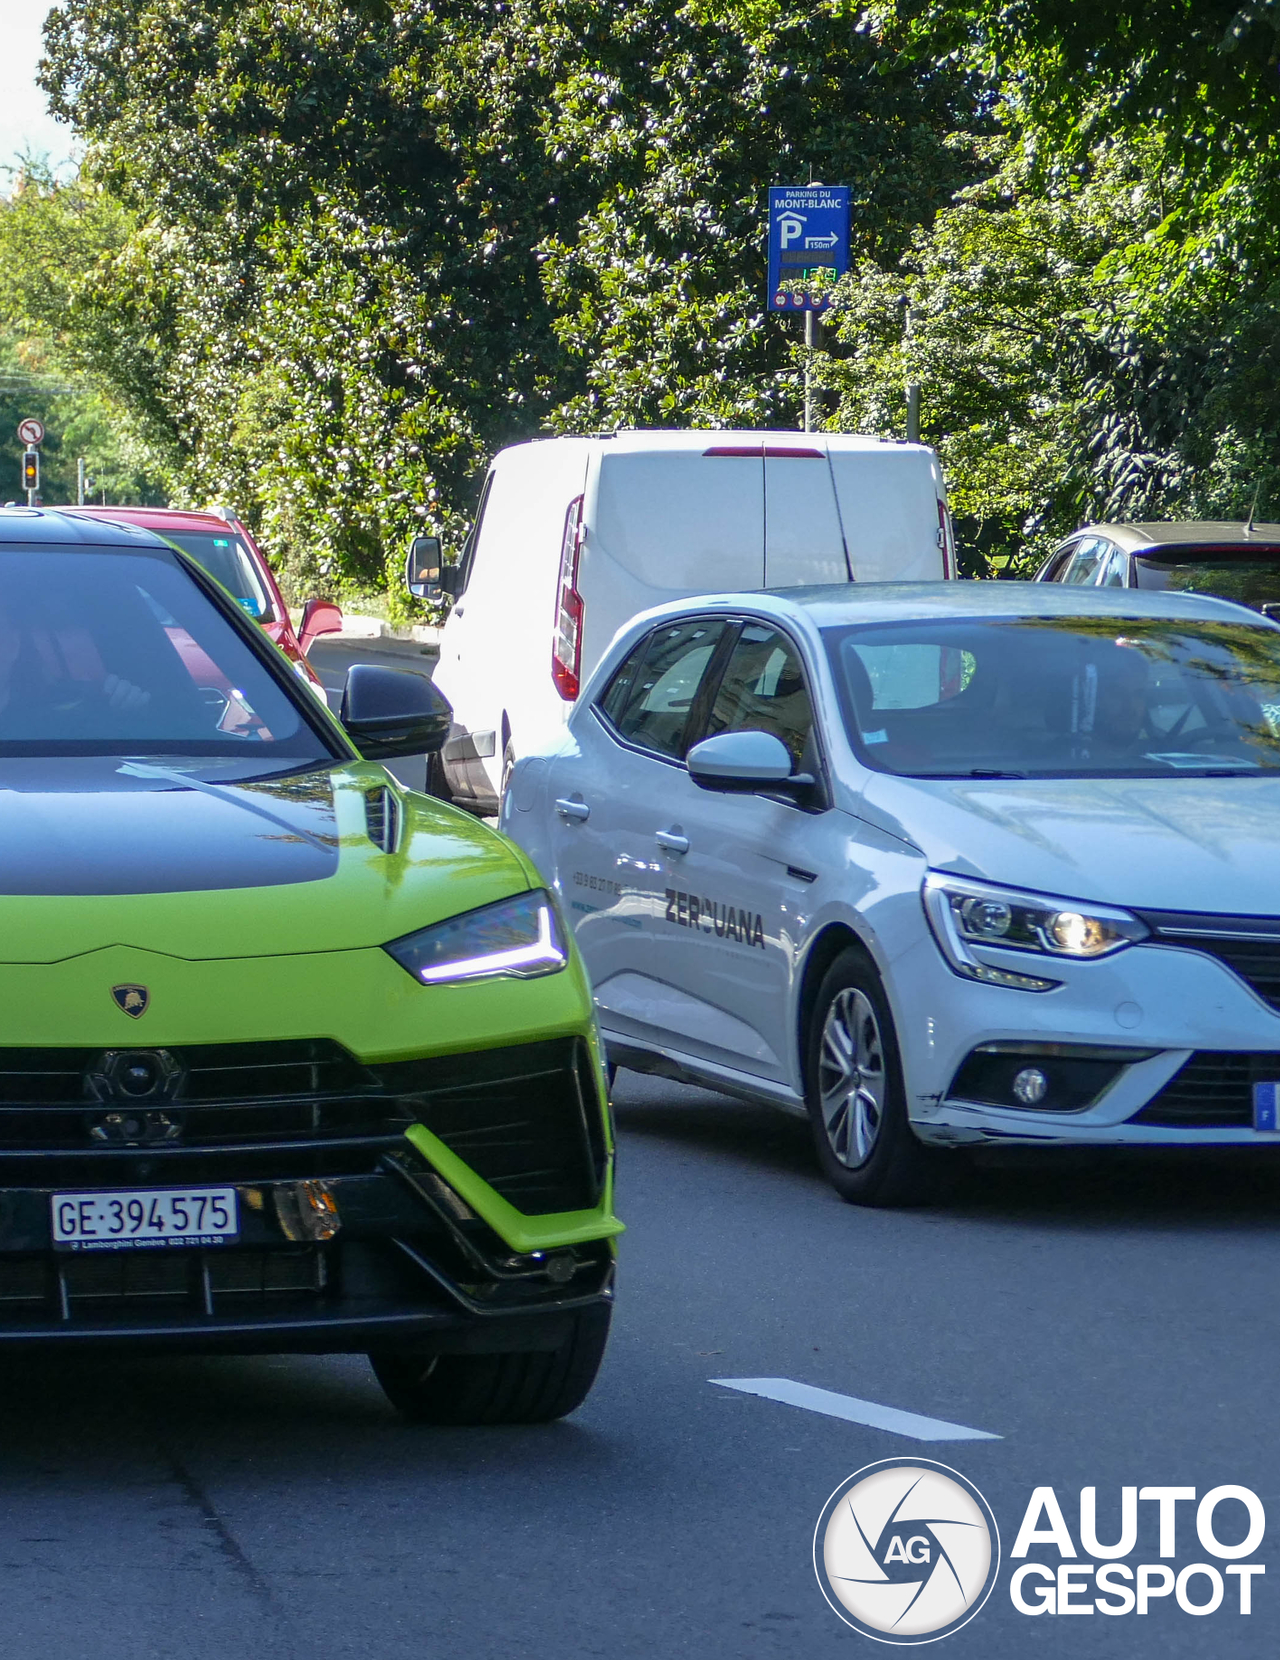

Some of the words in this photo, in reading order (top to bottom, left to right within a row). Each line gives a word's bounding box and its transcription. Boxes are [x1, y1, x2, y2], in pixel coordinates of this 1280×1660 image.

[775, 199, 841, 208] MONT-BLANC
[781, 220, 802, 249] P
[809, 241, 830, 249] 150m
[81, 1239, 134, 1250] Lamborghini
